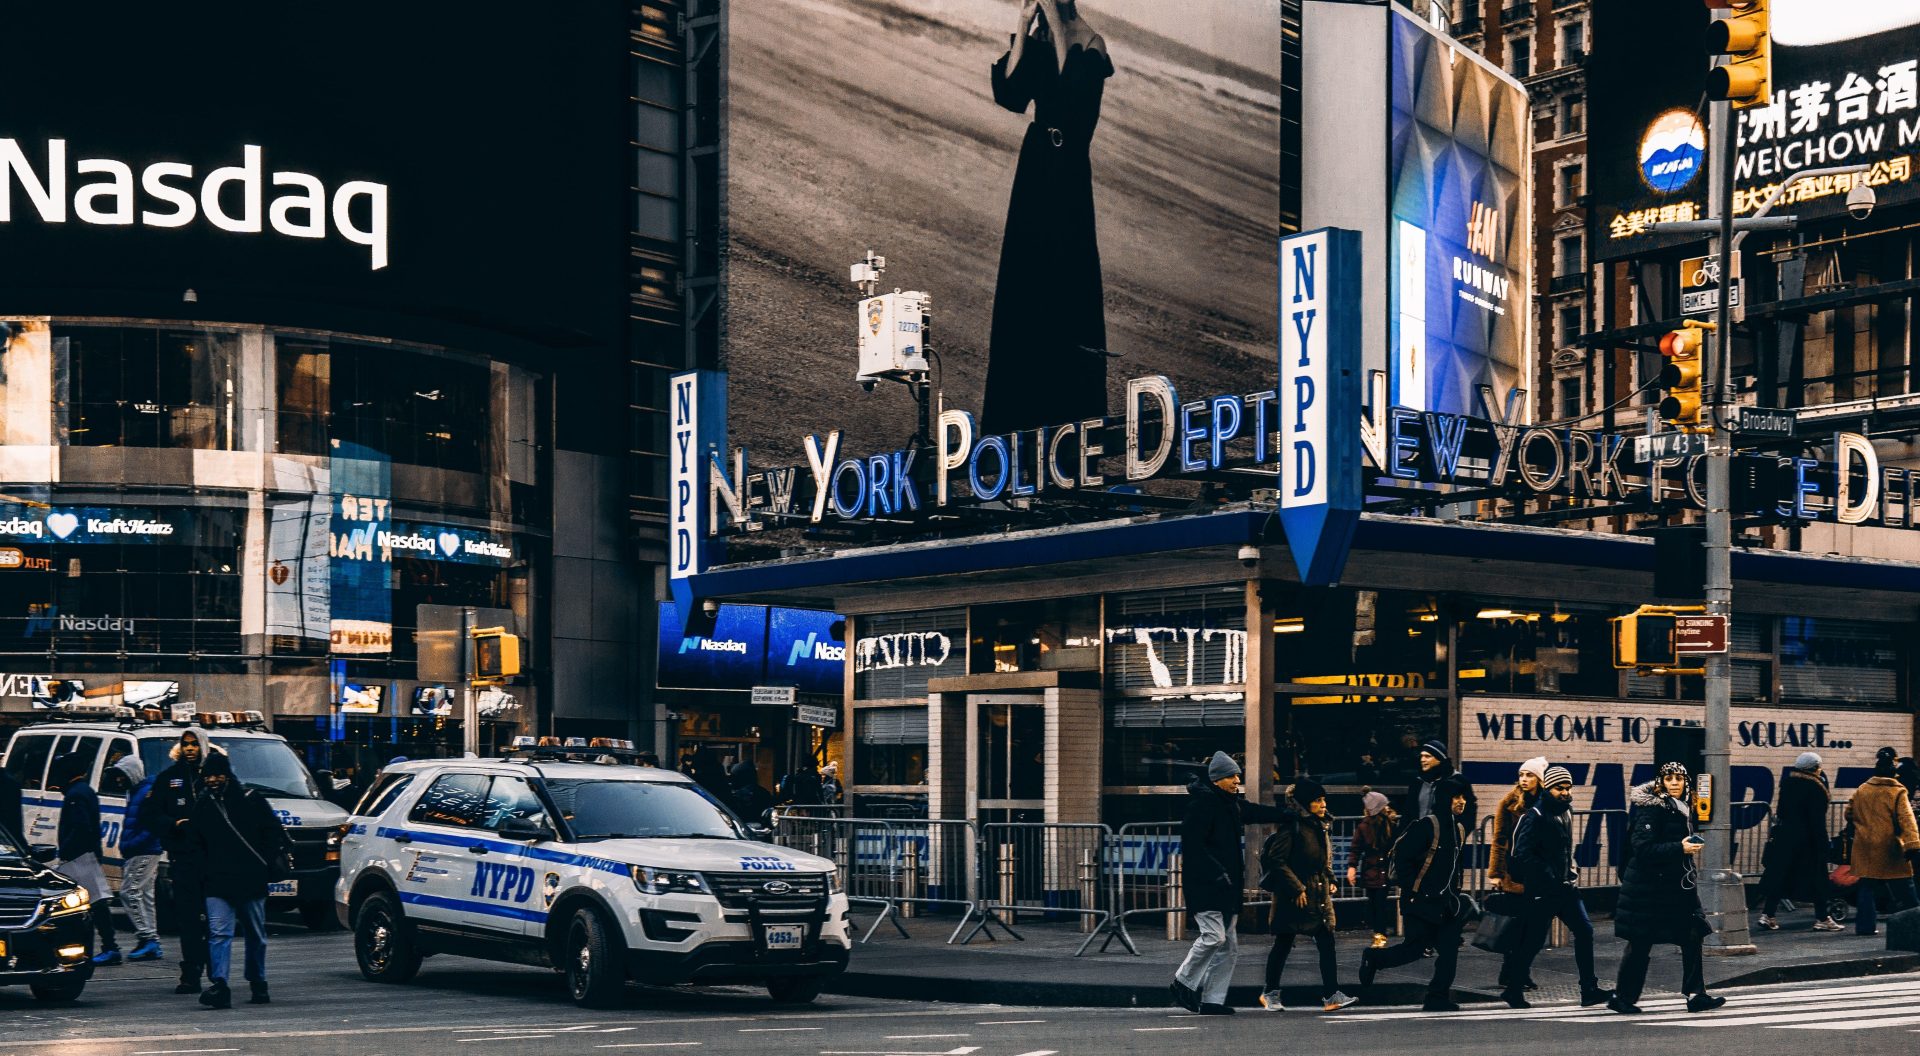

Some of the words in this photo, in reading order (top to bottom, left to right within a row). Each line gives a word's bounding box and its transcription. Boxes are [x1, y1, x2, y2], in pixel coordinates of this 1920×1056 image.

[1736, 60, 1919, 148] 州茅台酒
[0, 138, 388, 270] Nasdaq
[1453, 256, 1510, 301] RUNWAY
[1684, 292, 1706, 309] BIKE
[1709, 287, 1737, 306] LE
[1292, 243, 1317, 498] NYPD
[1476, 383, 1629, 499] YORK
[1742, 410, 1795, 437] Broadway
[803, 430, 919, 524] YORK
[937, 409, 1104, 507] POLICE
[1126, 375, 1277, 482] DEPT
[1652, 436, 1667, 457] W
[1671, 433, 1690, 455] 43
[675, 380, 692, 572] NYPD
[377, 530, 436, 556] Nasdaq
[59, 613, 135, 635] Nasdaq
[700, 638, 747, 655] Nasdaq
[1475, 712, 1612, 743] WELCOME
[1617, 715, 1651, 744] TO
[470, 860, 536, 903] NYPD
[739, 861, 796, 871] POLICE
